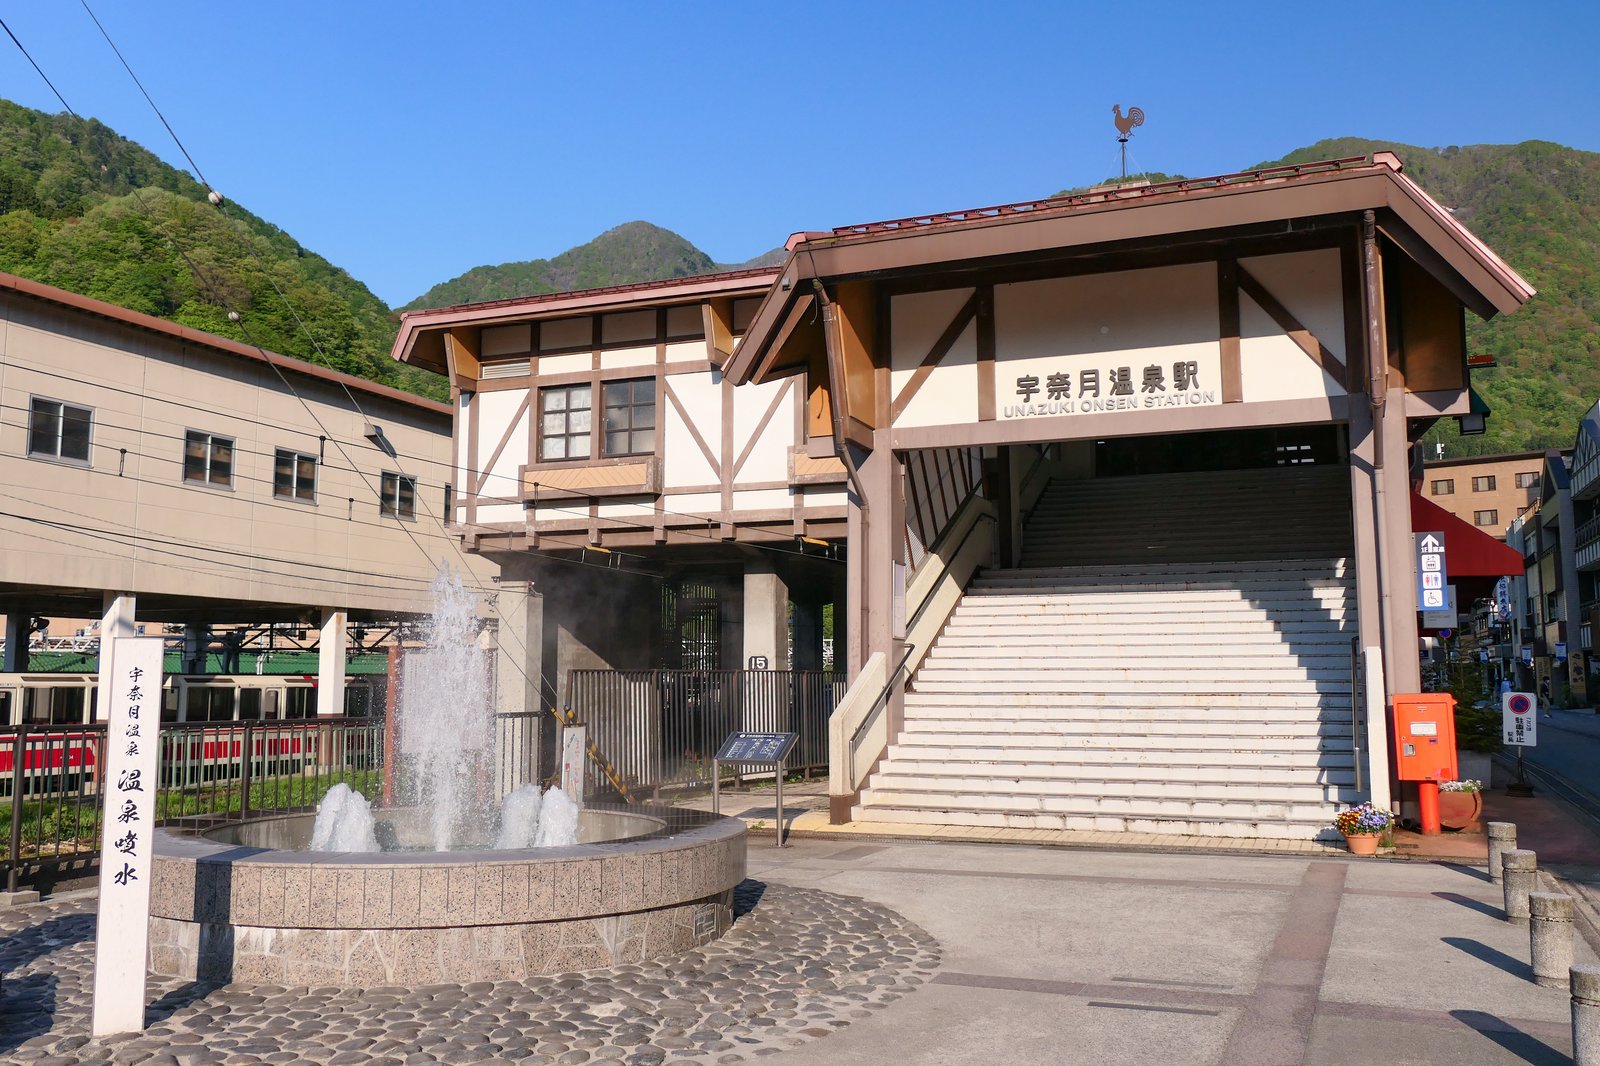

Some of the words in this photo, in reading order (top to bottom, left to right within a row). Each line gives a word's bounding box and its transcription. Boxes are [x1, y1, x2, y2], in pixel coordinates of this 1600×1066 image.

[1016, 360, 1199, 403] 宇奈月温泉駅
[1004, 401, 1075, 418] UNAZUKI
[1080, 395, 1138, 413] ONSEN
[1144, 390, 1215, 408] STATION
[751, 657, 766, 669] 15
[126, 666, 144, 757] 宇奈月温泉
[114, 768, 145, 886] 温泉噴水
